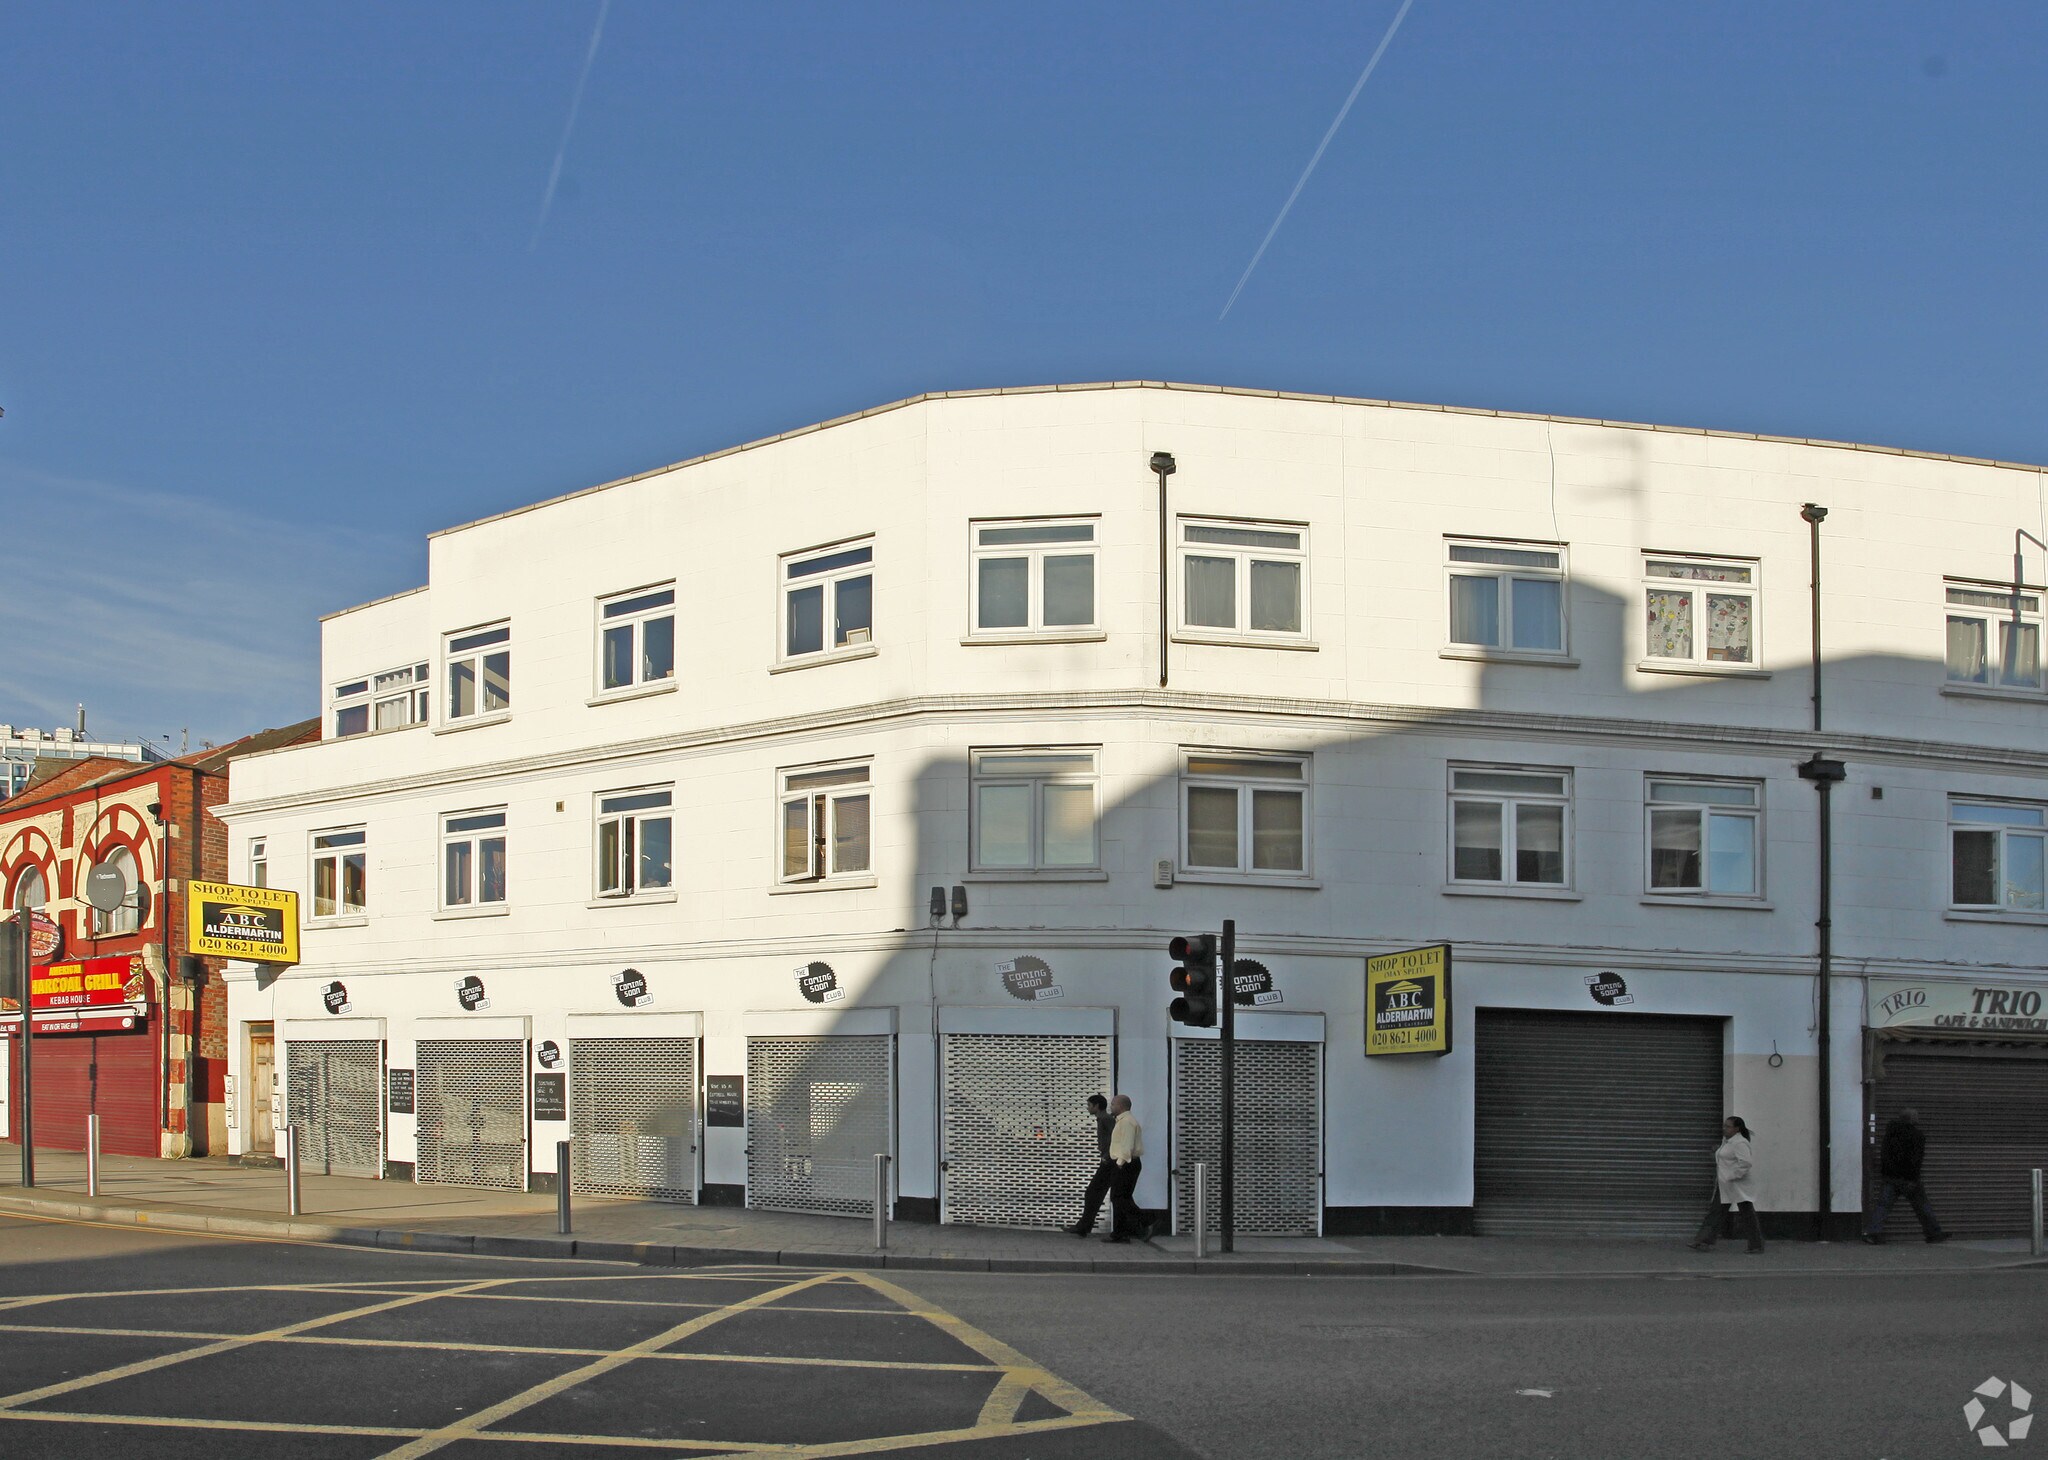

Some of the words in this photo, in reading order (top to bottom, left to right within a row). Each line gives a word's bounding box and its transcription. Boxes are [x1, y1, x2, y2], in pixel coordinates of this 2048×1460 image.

[193, 884, 234, 896] SHOP
[238, 889, 258, 898] TO
[263, 892, 291, 903] LET
[205, 924, 282, 940] ALDERMARTIN
[198, 938, 222, 949] 020
[226, 940, 254, 952] 8621
[259, 944, 288, 955] 4000
[1370, 958, 1398, 973] SHOP
[1400, 954, 1416, 968] TO
[1420, 951, 1440, 966] LET
[1008, 969, 1046, 982] COMING
[1384, 970, 1401, 978] (MAY
[1404, 968, 1426, 976] SPLIT)
[32, 976, 83, 994] HARCOAL
[84, 973, 122, 991] GRILL
[804, 973, 832, 986] COMING
[1017, 978, 1042, 988] SOON
[1234, 974, 1266, 984] OMING
[461, 986, 482, 996] COMING
[619, 980, 643, 991] COMING
[810, 982, 828, 992] SOON
[1236, 982, 1262, 994] SOON
[1594, 982, 1622, 991] COMING
[466, 993, 480, 1002] SOON
[624, 988, 640, 998] SOON
[826, 990, 842, 1000] CLUB
[1039, 988, 1060, 997] CLUB
[1258, 994, 1278, 1002] CLUB
[50, 996, 69, 1004] KEBAB
[638, 996, 651, 1004] CLUB
[1881, 990, 1926, 1016] TRIO
[1972, 988, 2042, 1017] TRIO
[1376, 1008, 1433, 1024] ALDERMARTIN
[1970, 1016, 1979, 1028] &
[1372, 1032, 1387, 1045] 020
[1390, 1031, 1411, 1044] 8621
[1415, 1029, 1437, 1042] 4000
